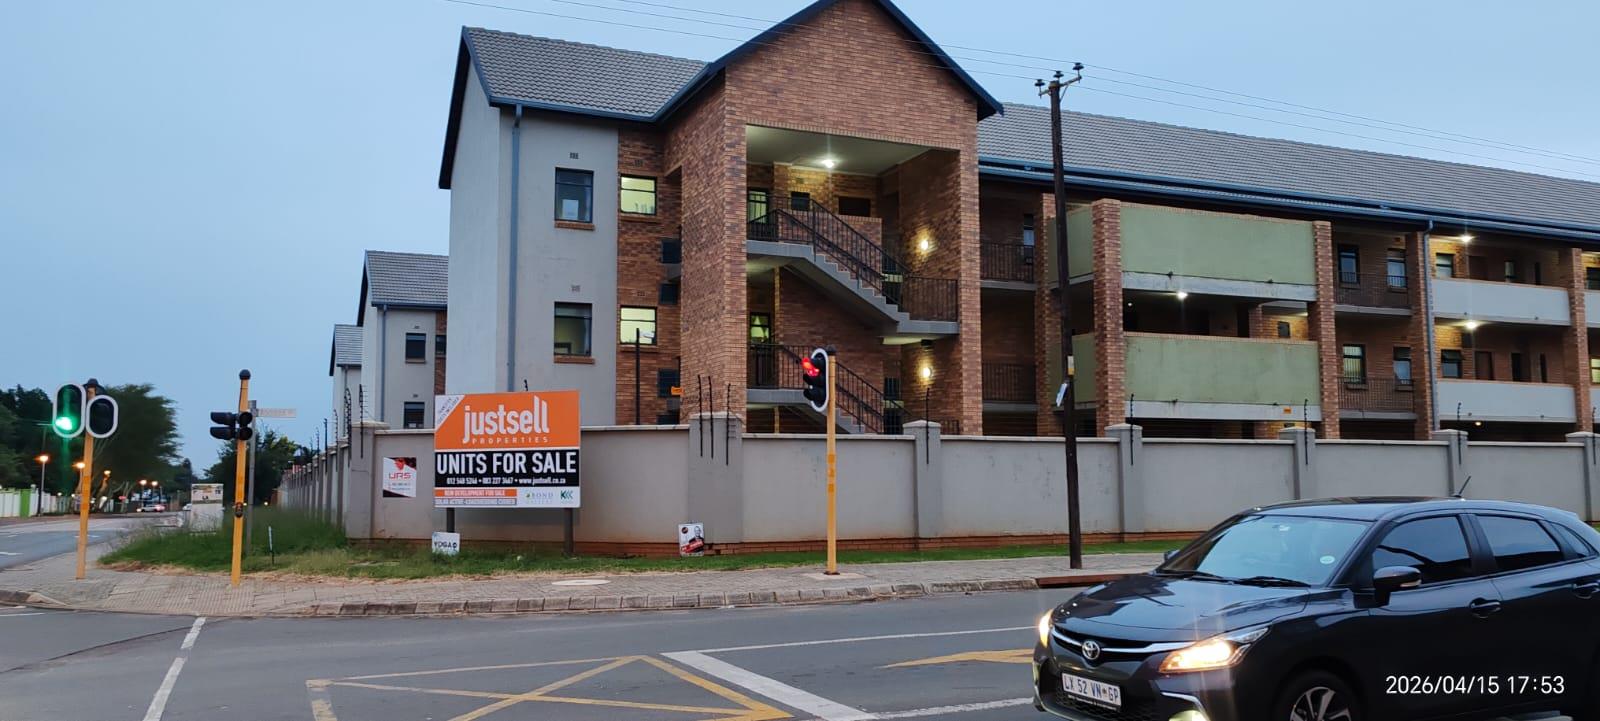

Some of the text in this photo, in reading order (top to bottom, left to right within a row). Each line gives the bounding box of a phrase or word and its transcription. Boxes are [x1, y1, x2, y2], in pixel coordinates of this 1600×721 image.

[462, 395, 550, 444] justsell
[472, 436, 549, 445] PROPERTIES
[436, 451, 577, 474] UNITS FOR SALE
[1063, 674, 1074, 691] LX
[1077, 678, 1088, 695] 52
[1090, 681, 1102, 699] VN
[1108, 686, 1119, 703] GP
